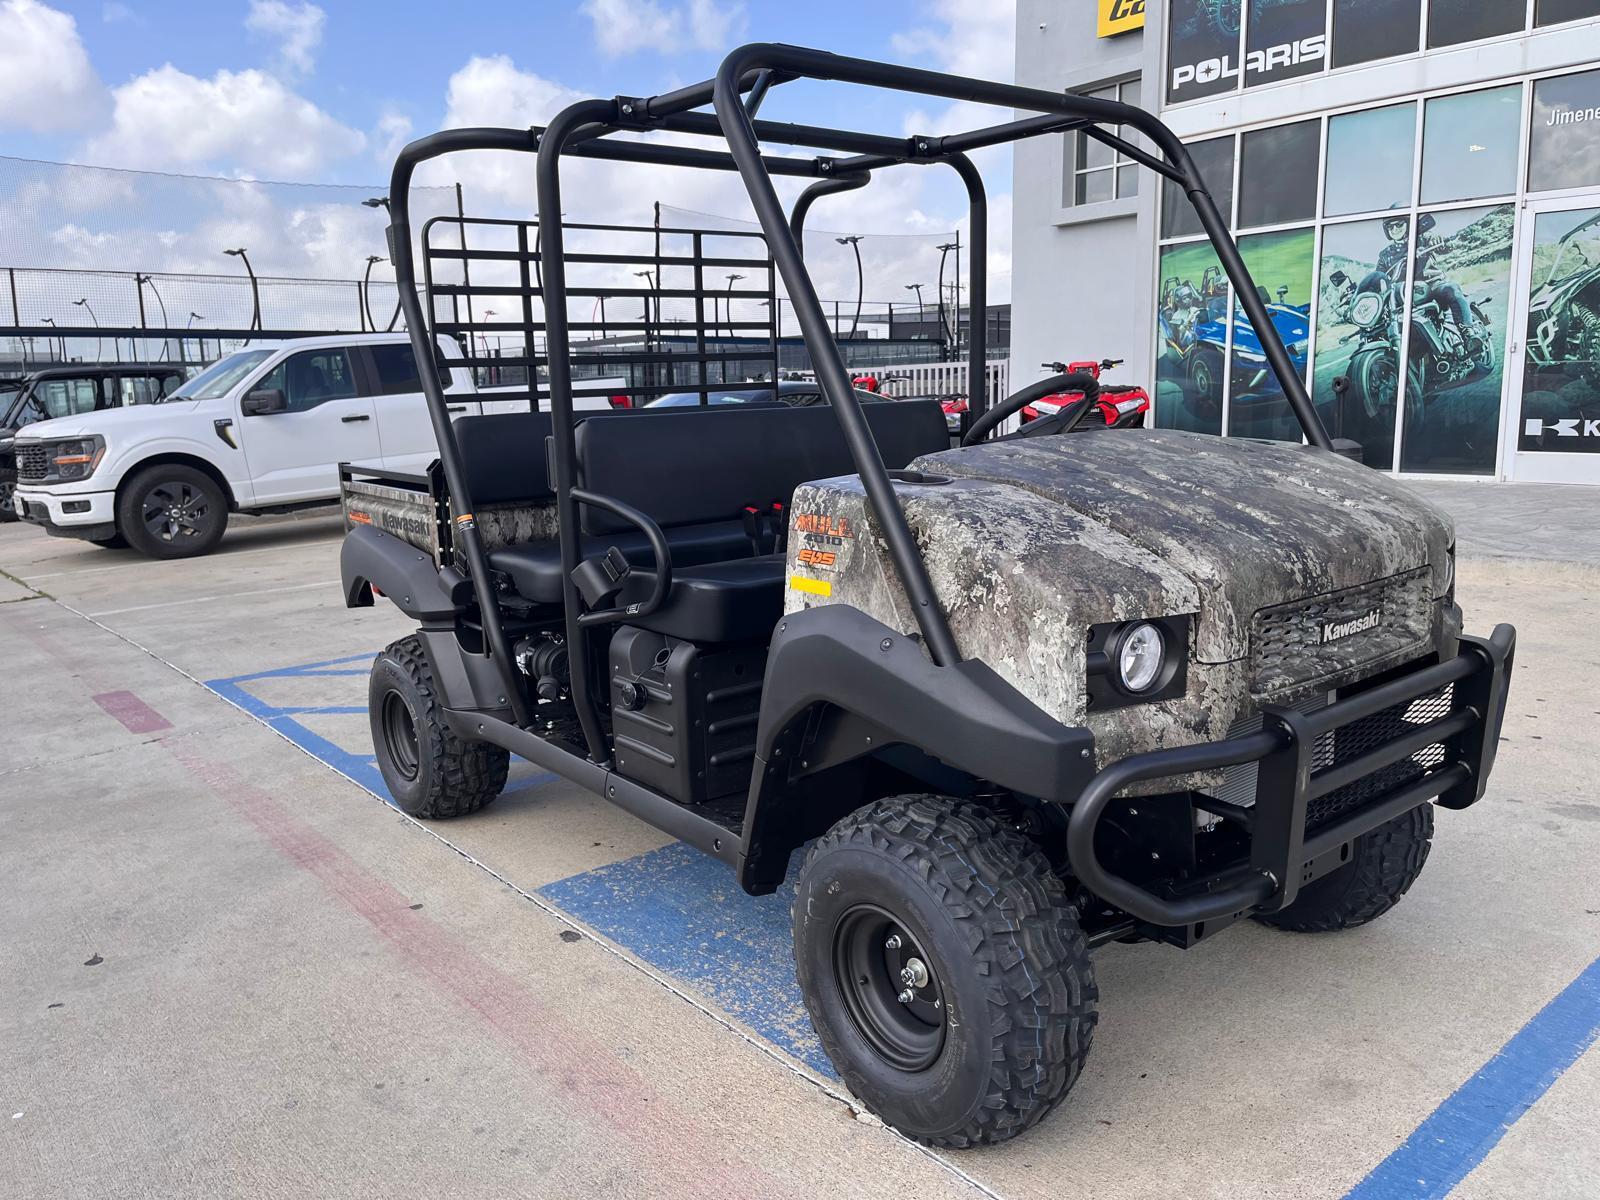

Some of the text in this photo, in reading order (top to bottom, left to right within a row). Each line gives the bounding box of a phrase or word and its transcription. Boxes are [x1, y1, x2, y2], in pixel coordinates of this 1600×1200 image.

[1172, 34, 1325, 90] POLARIS
[382, 510, 431, 537] Kawasaki
[1323, 608, 1380, 643] Kawasaki
